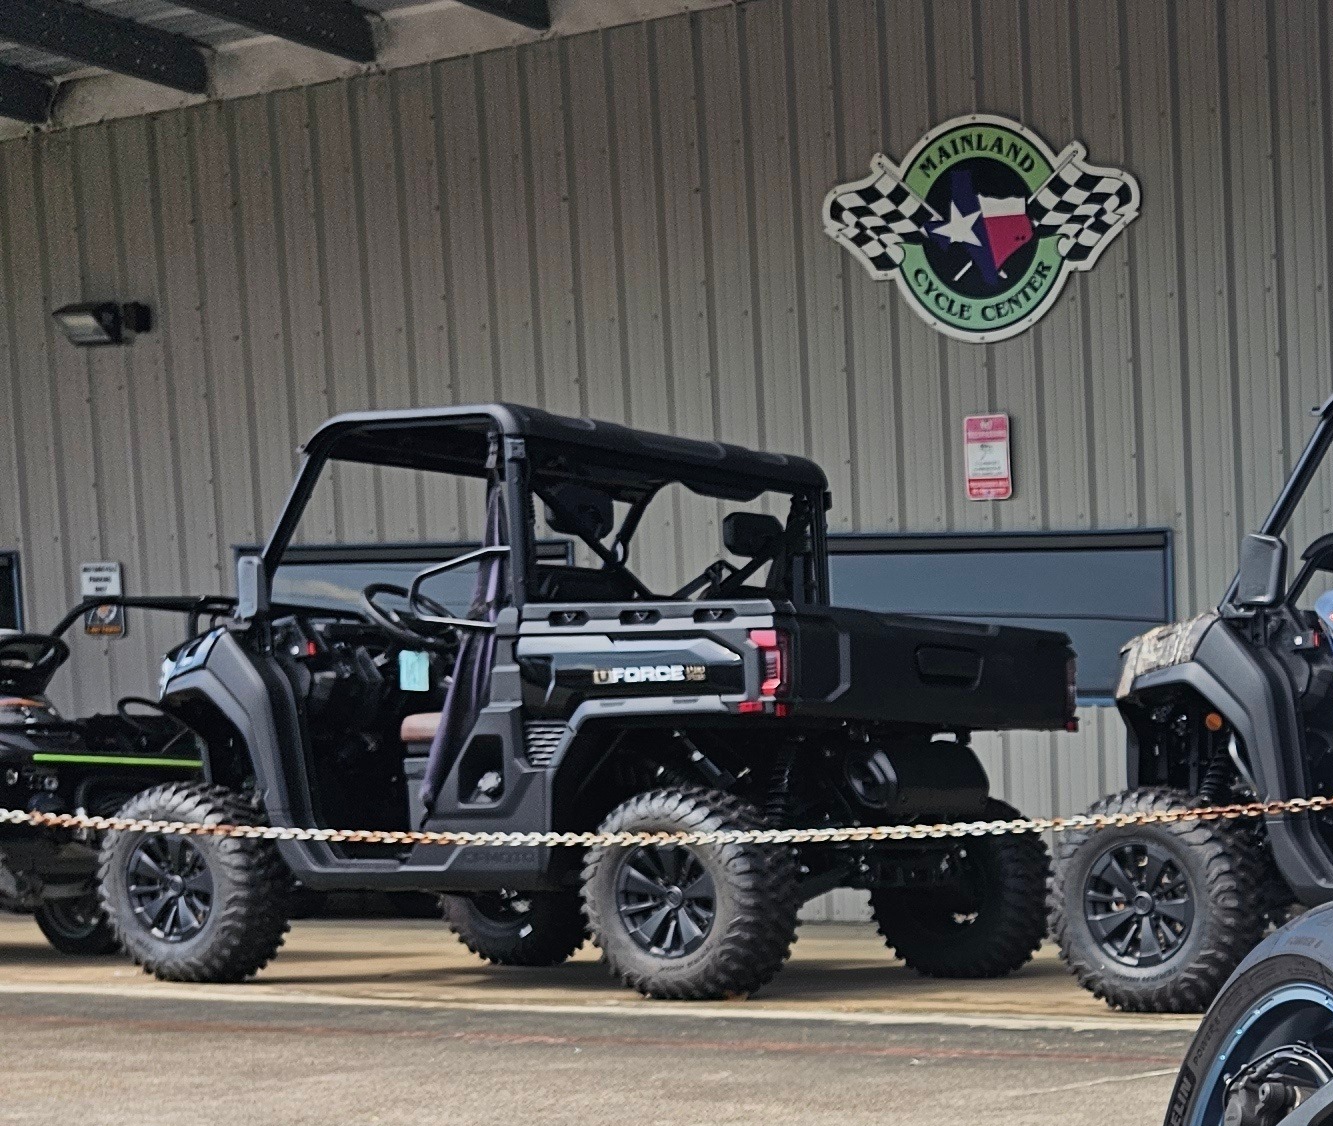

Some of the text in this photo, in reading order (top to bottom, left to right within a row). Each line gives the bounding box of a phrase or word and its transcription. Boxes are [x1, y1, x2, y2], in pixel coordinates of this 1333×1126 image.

[919, 132, 1036, 178] MAINLAND
[913, 260, 1053, 322] CYCLE CENTER
[593, 664, 686, 685] UFORCE
